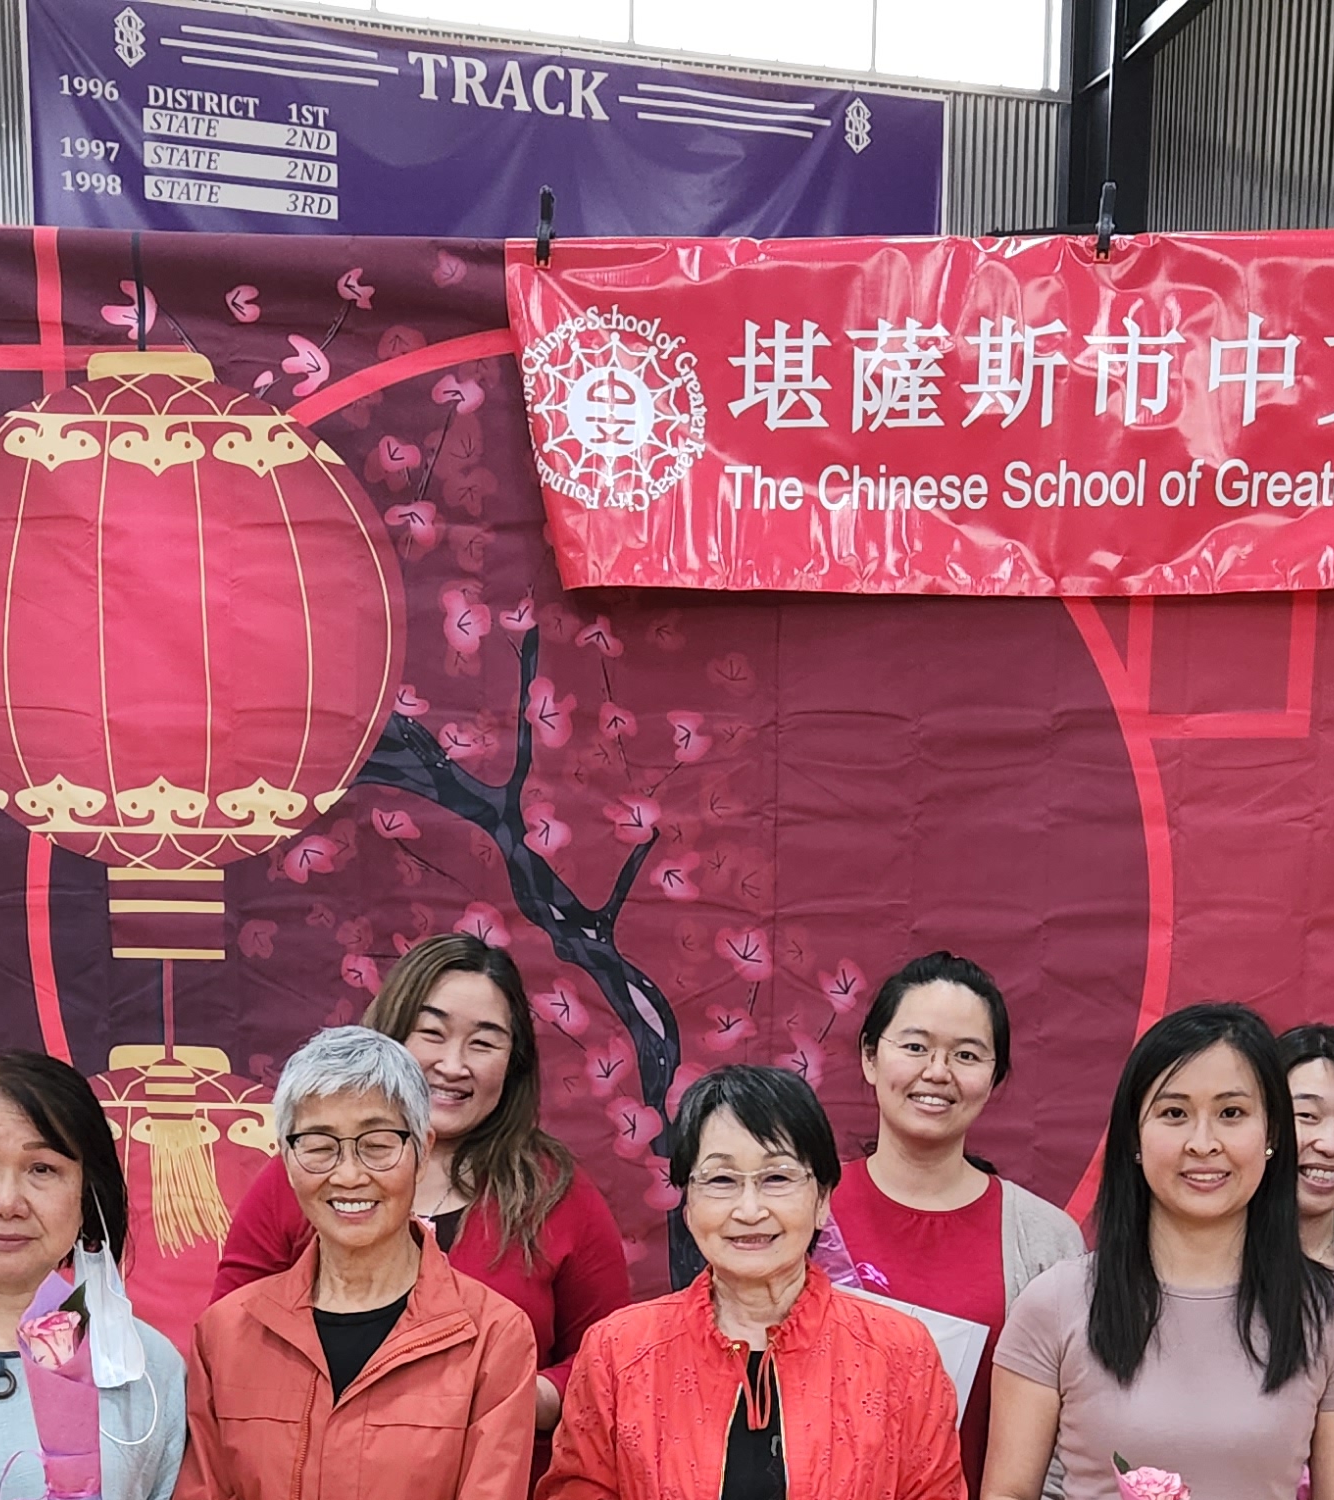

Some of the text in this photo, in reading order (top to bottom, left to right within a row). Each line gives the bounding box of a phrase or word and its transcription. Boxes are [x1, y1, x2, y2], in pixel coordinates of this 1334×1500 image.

[59, 74, 330, 128] 1996 DISTRICT 1ST
[408, 51, 610, 121] TRACK
[149, 112, 331, 151] STATE 2ND
[60, 137, 332, 183] 1997 STATE 2ND
[60, 170, 332, 215] 1998 STATE 3RD
[522, 316, 586, 373] Chinese
[586, 304, 661, 341] School
[657, 333, 685, 359] of
[675, 352, 707, 438] Greater
[604, 487, 649, 512] City
[724, 465, 804, 511] The
[817, 465, 988, 512] Chinese
[1002, 459, 1146, 509] School
[1160, 458, 1205, 507] of
